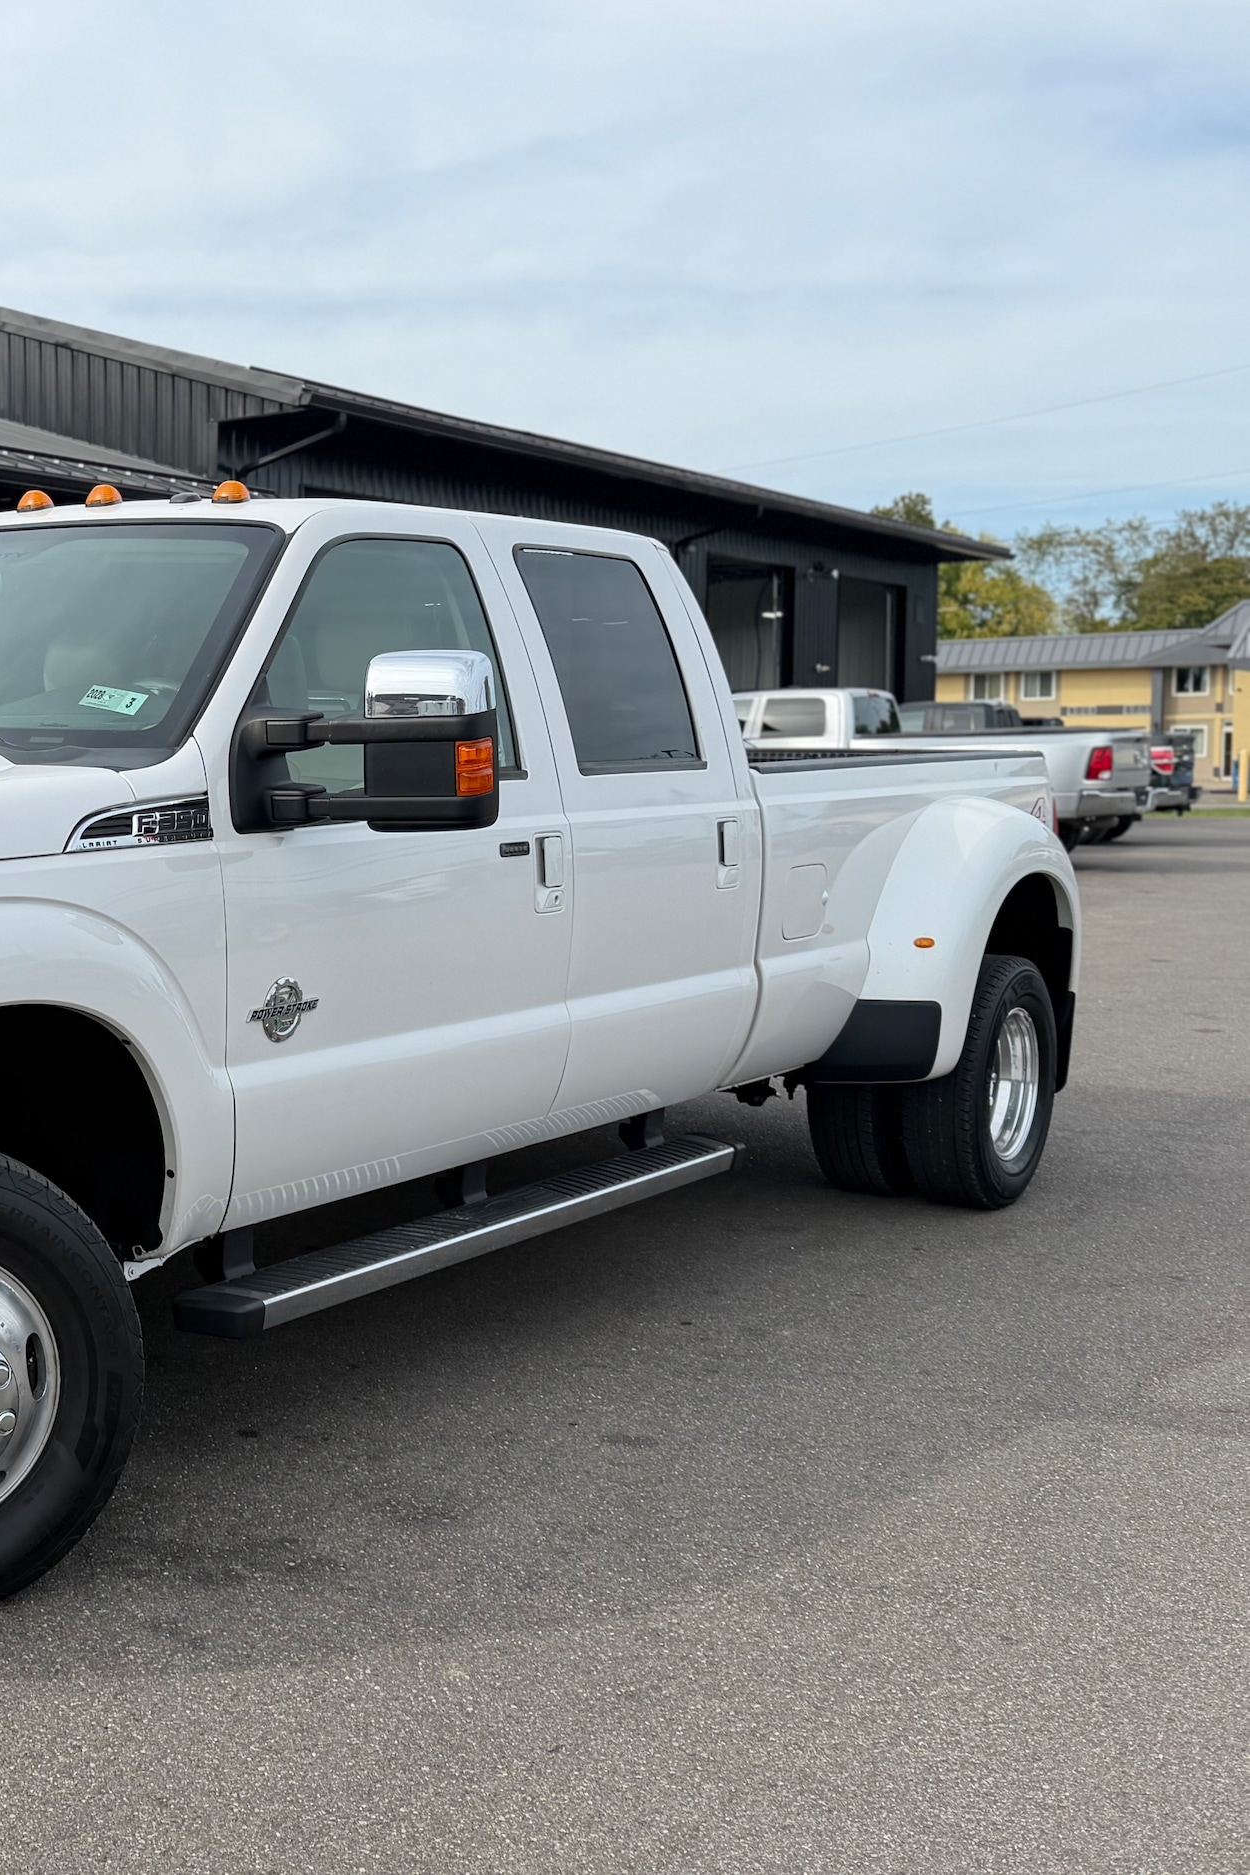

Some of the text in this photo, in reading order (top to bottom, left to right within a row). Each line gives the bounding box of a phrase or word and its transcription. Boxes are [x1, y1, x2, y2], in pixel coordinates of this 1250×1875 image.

[125, 697, 137, 709] 3
[82, 839, 118, 849] LARIAT
[250, 999, 319, 1021] POWER STROKE
